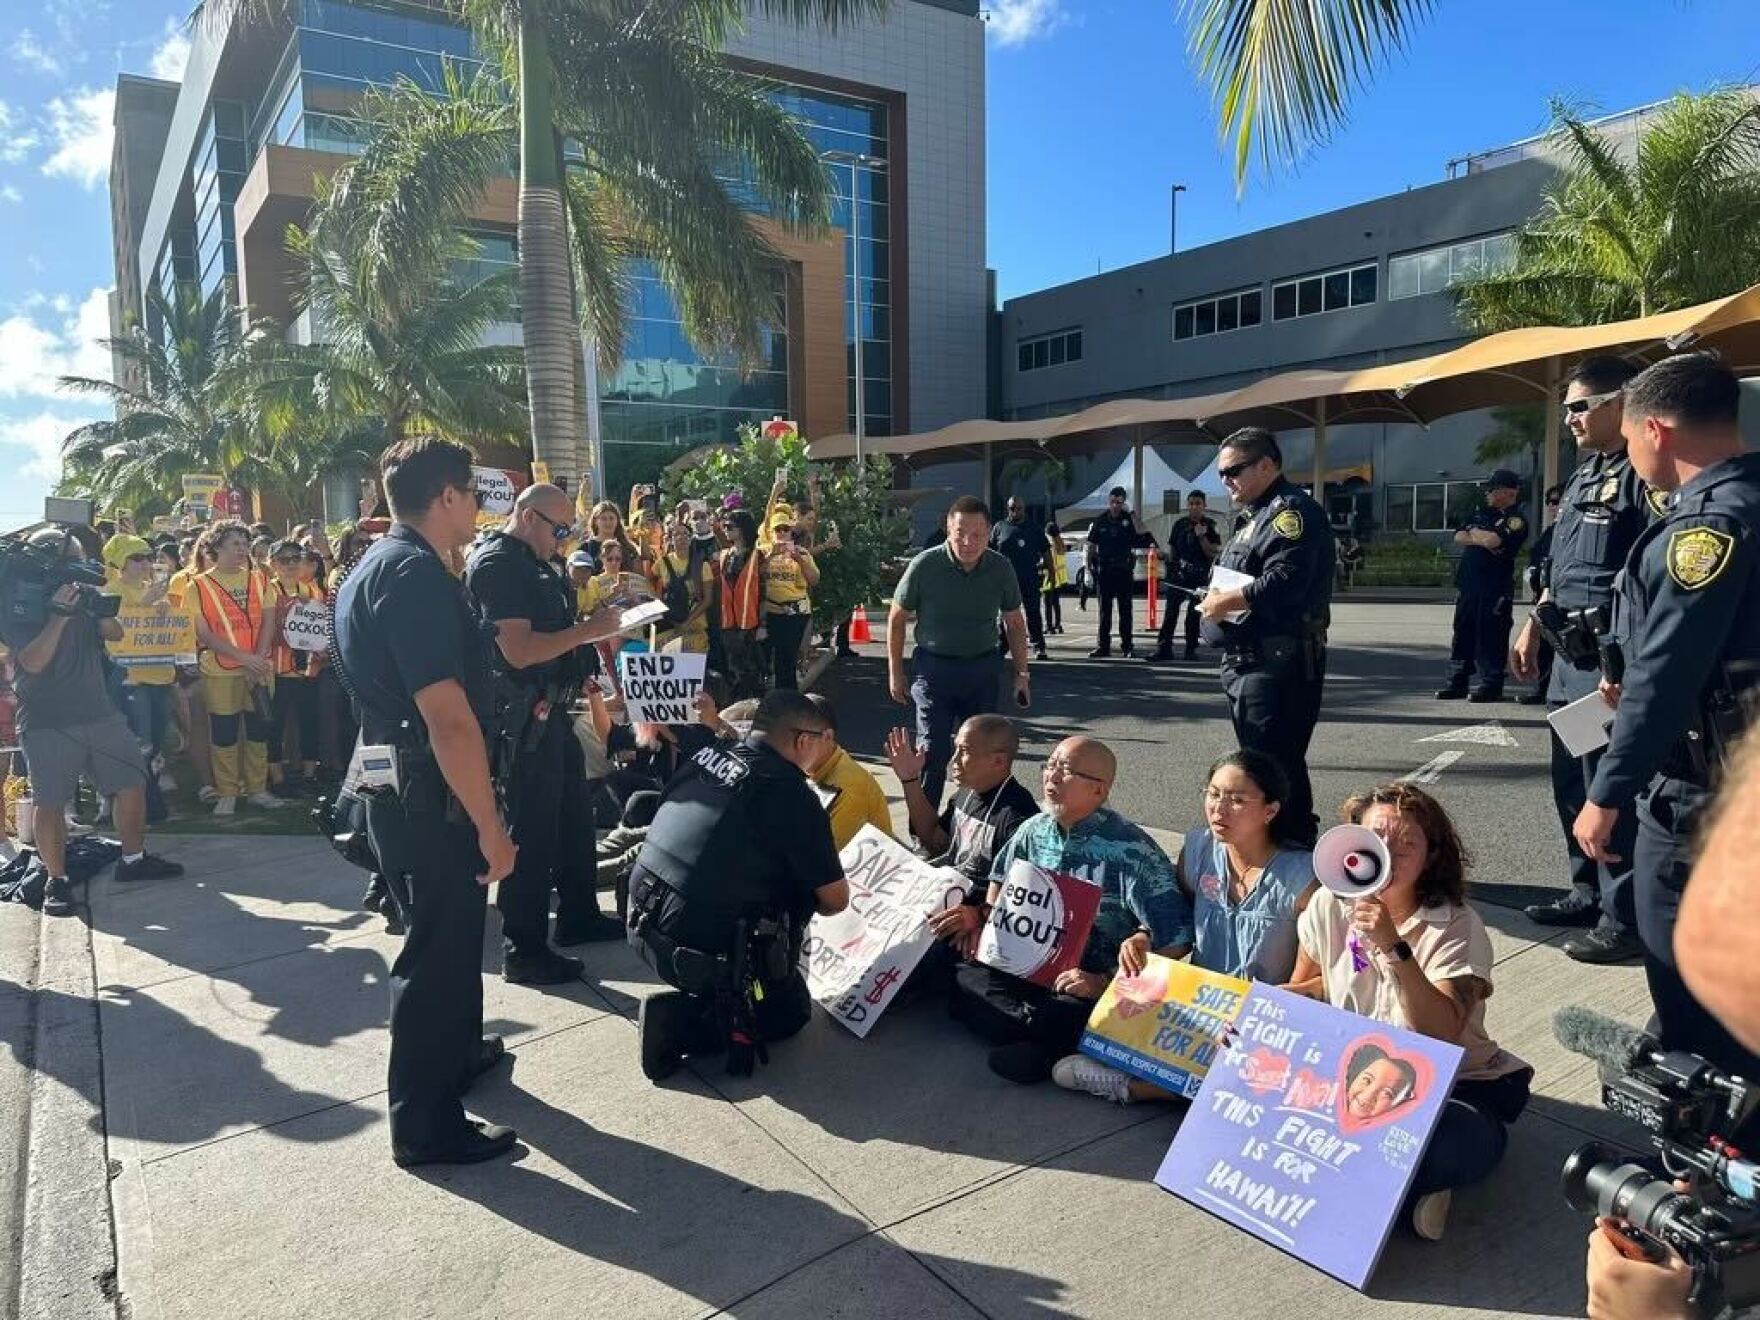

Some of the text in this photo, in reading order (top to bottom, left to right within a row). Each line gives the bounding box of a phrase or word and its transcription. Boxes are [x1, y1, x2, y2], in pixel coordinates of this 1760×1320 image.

[626, 656, 675, 676] END
[624, 678, 702, 701] LOCKOUT
[641, 703, 688, 722] NOW
[691, 746, 743, 787] POLICE
[844, 837, 913, 896] SAVE
[1192, 984, 1242, 1013] SAFE
[1252, 997, 1287, 1021] This
[1154, 1026, 1193, 1056] FOR
[1240, 1015, 1322, 1064] FIGHT is
[1210, 1090, 1266, 1128] THIS
[1275, 1116, 1362, 1166] FIGHT
[1240, 1136, 1318, 1184] IS FOR
